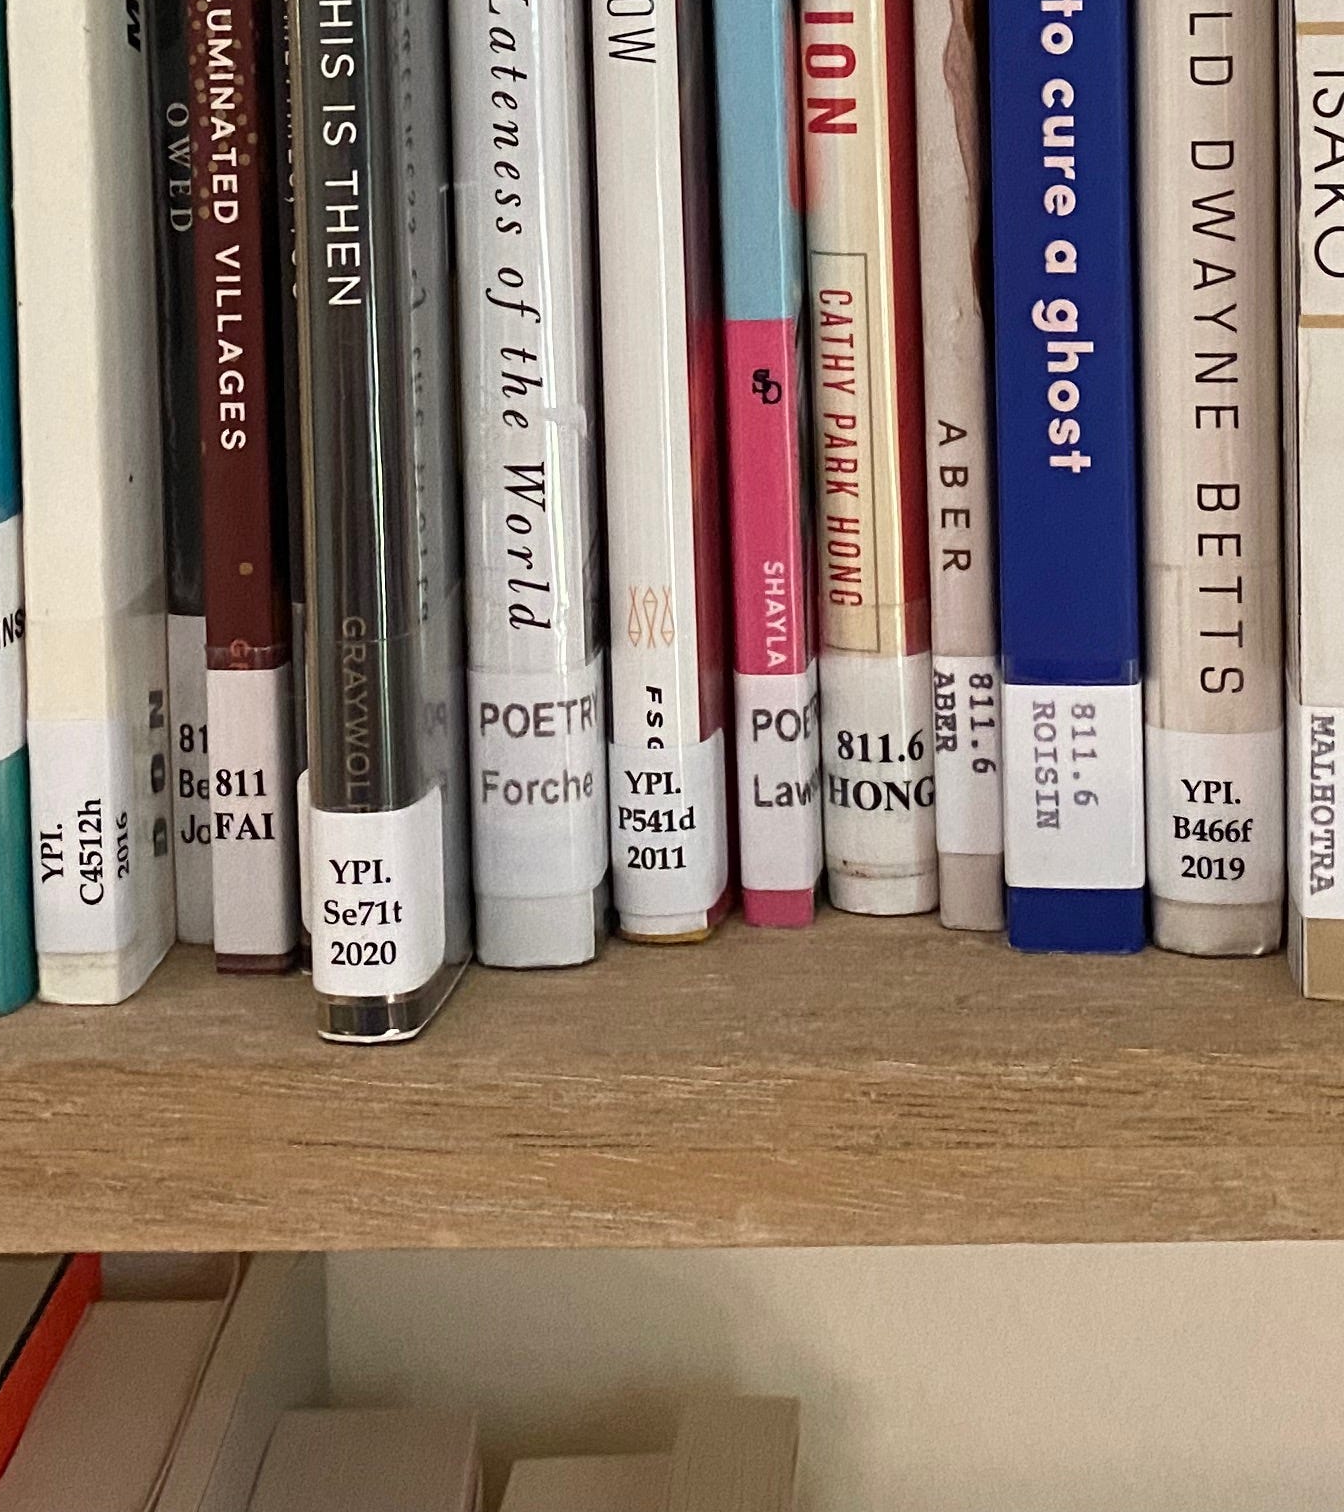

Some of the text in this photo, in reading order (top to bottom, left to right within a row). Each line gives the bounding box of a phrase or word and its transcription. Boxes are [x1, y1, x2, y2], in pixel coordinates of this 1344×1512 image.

[165, 101, 193, 233] OWED
[322, 103, 357, 147] IS
[1040, 77, 1078, 218] cure
[324, 169, 363, 307] THEN
[1043, 238, 1079, 275] a
[1190, 138, 1240, 431] DWAYNE
[1030, 298, 1095, 475] ghost
[819, 288, 864, 608] CATHY PARK HONG
[763, 560, 787, 669] SHAYLA
[1196, 481, 1246, 696] BETTS
[837, 728, 925, 766] 811.6
[933, 669, 958, 755] ABER
[968, 671, 997, 776] 811.6
[1069, 700, 1099, 808] 811.6
[214, 812, 276, 841] FAI
[215, 769, 268, 798] 811
[482, 770, 594, 806] Forche
[828, 774, 936, 813] HONG
[1309, 712, 1337, 896] MALHOTRA
[78, 796, 104, 908] C4512h
[625, 845, 687, 871] 2011
[1172, 815, 1254, 844] B466f
[1180, 853, 1247, 882] 2019
[323, 900, 404, 926] Se71t
[330, 940, 398, 966] 2020
